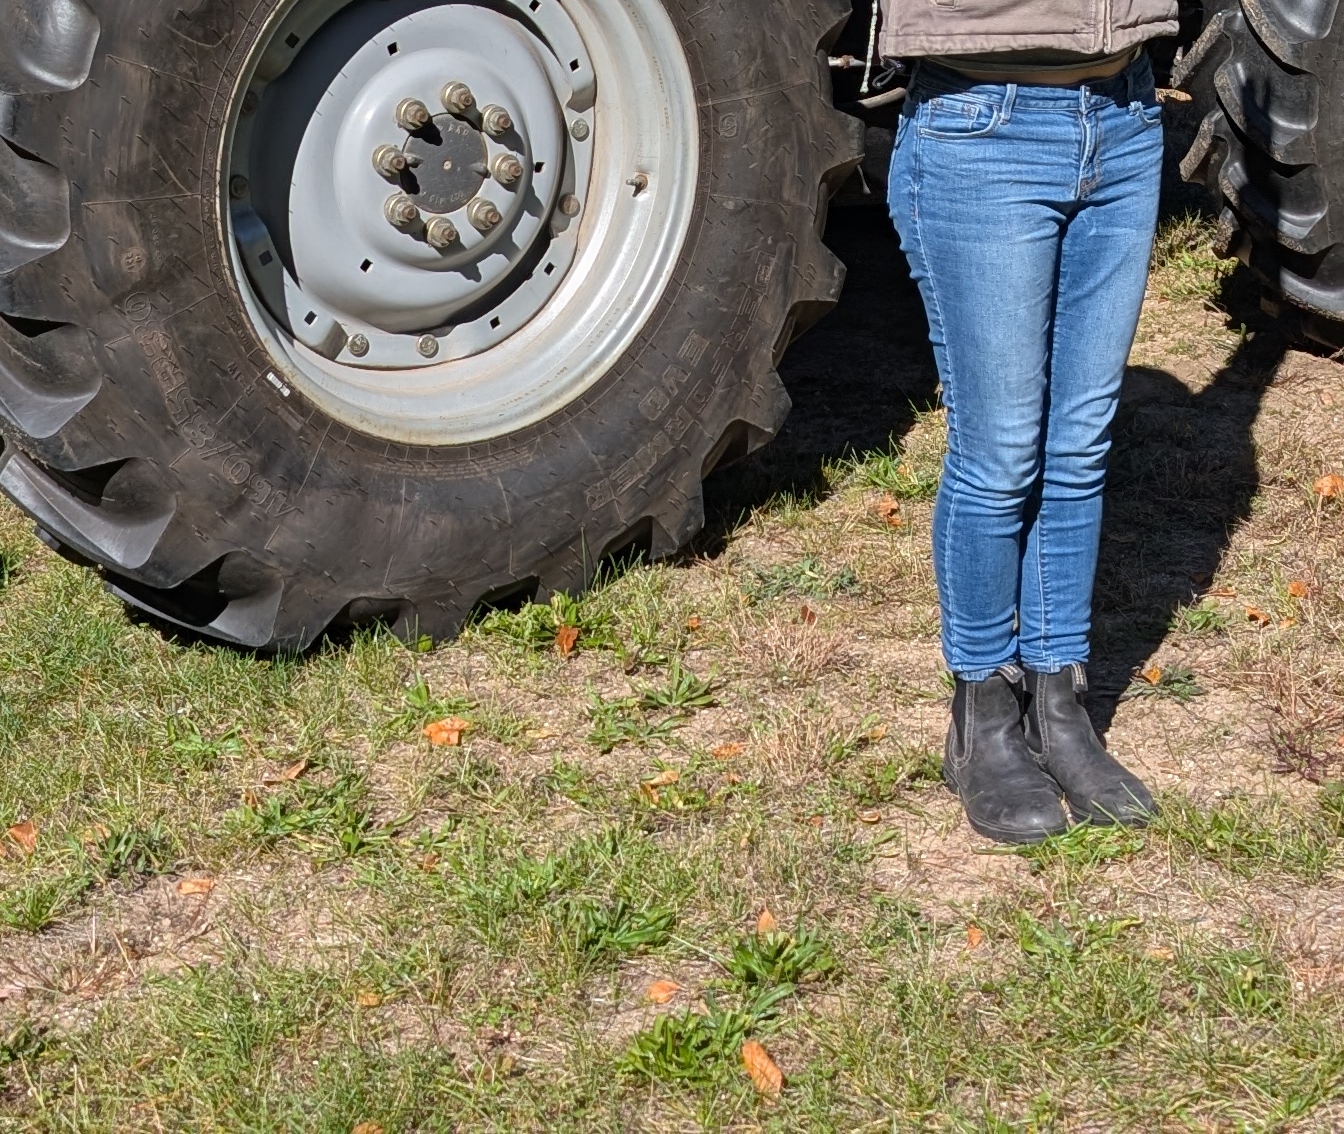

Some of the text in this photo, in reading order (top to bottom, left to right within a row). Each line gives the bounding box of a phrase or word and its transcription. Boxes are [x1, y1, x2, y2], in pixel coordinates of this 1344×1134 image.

[226, 361, 255, 397] R-1W
[582, 251, 776, 512] PERFORMER
[637, 328, 711, 422] EVO
